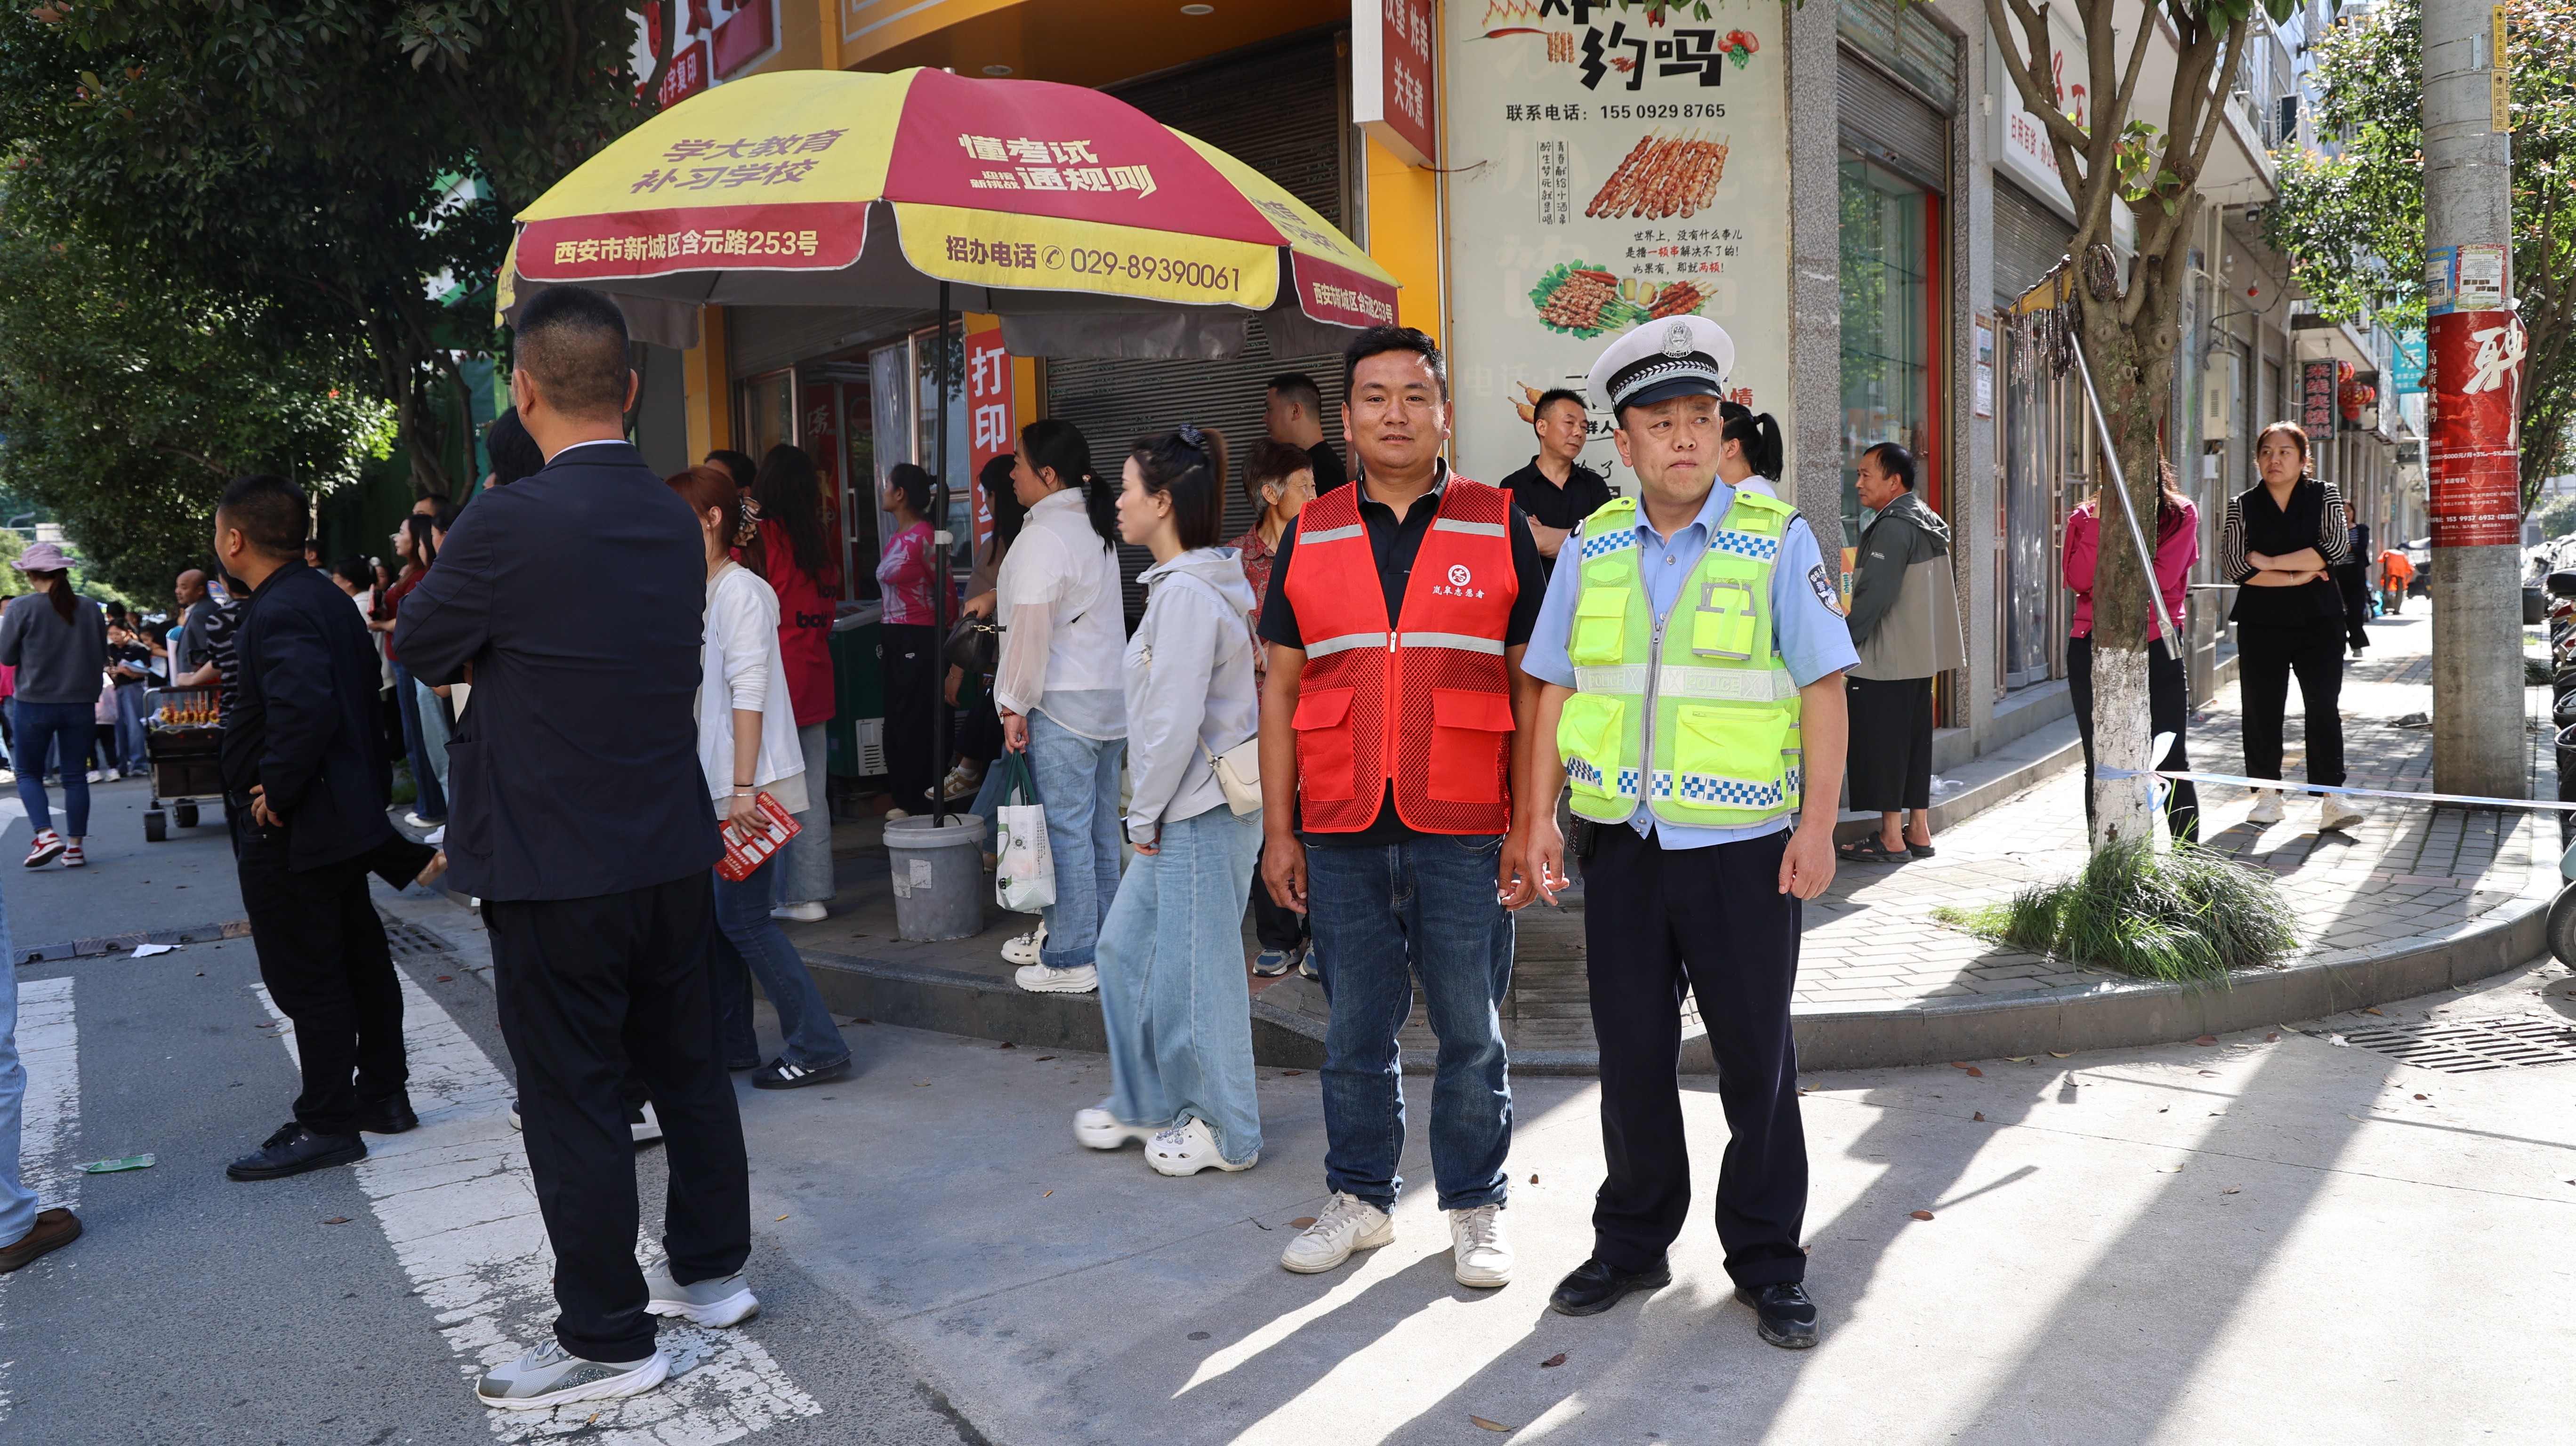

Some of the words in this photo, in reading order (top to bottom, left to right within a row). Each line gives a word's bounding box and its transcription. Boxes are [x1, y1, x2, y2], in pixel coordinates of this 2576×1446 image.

[1409, 2, 1429, 64] 炸串
[1579, 20, 1722, 91] 约吗
[1394, 56, 1424, 129] 关东煮
[1601, 104, 1631, 119] 155
[1636, 104, 1679, 119] 0929
[1683, 104, 1726, 118] 8765
[663, 128, 850, 162] 学大教育
[958, 133, 1099, 165] 懂考试
[2012, 113, 2037, 158] 日用百货
[2041, 137, 2061, 177] 办公用
[629, 158, 820, 194] 补习学校
[969, 179, 1021, 189] 新挑战
[982, 170, 1016, 181] 迎接
[1014, 165, 1158, 200] 通规则
[1539, 141, 1554, 225] 醉生梦死就是喝
[554, 229, 819, 265] 西安市新城区含元路253号
[946, 235, 1037, 270] 招办电话
[1071, 247, 1240, 292] 029-89390061
[1312, 282, 1393, 324] 西安市新城区含元路253号
[2462, 318, 2527, 449] 聘
[1432, 585, 1485, 599] 岚皋志愿者
[1589, 674, 1624, 687] POLICE
[1686, 674, 1739, 691] POLICE
